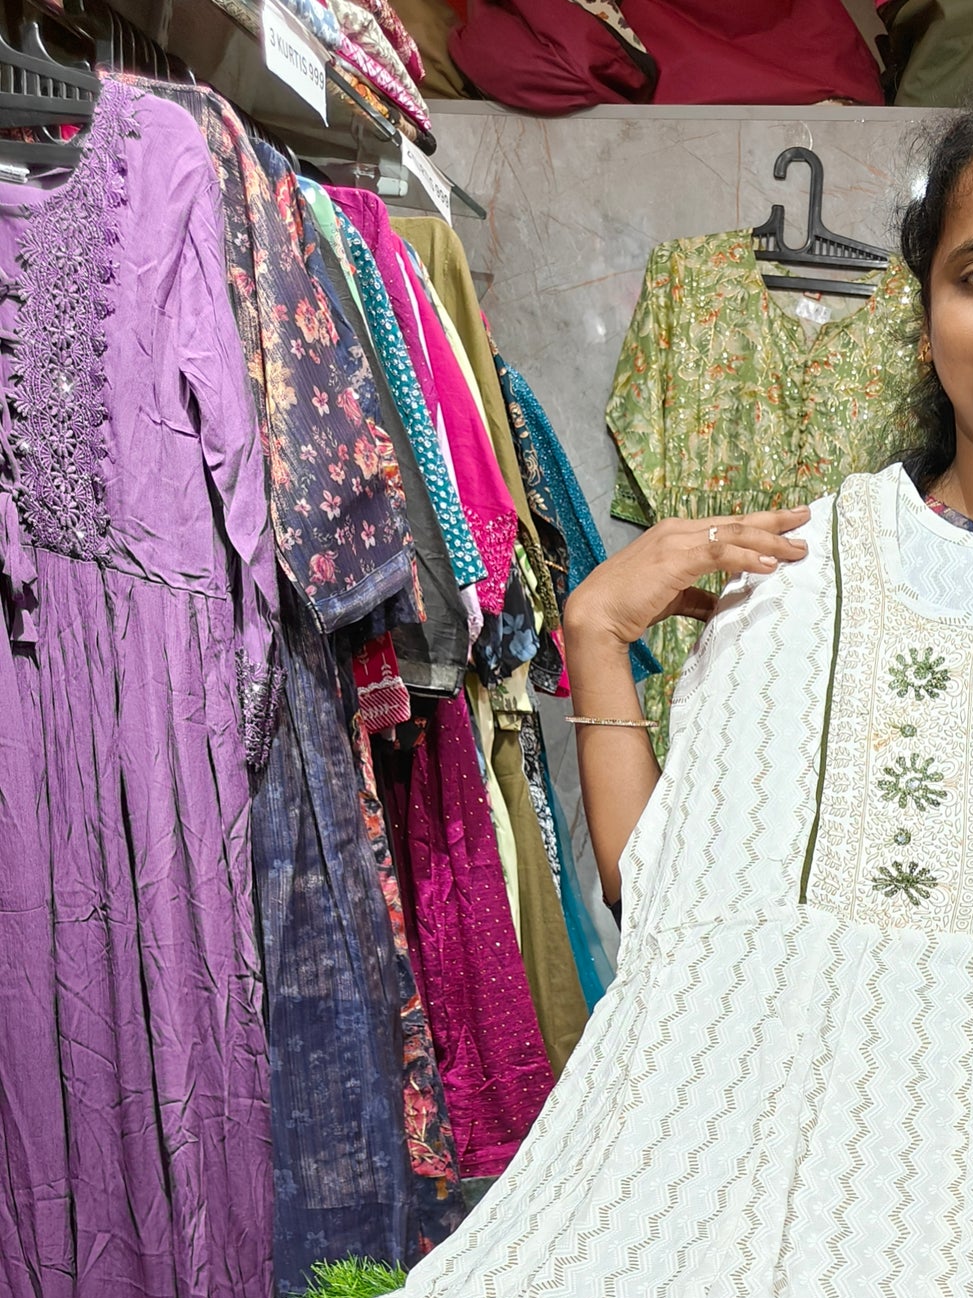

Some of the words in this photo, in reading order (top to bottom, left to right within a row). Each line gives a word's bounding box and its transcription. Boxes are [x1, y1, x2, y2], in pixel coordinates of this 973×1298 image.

[270, 27, 276, 47] 3
[276, 32, 308, 76] KURTIS
[309, 63, 325, 90] 999
